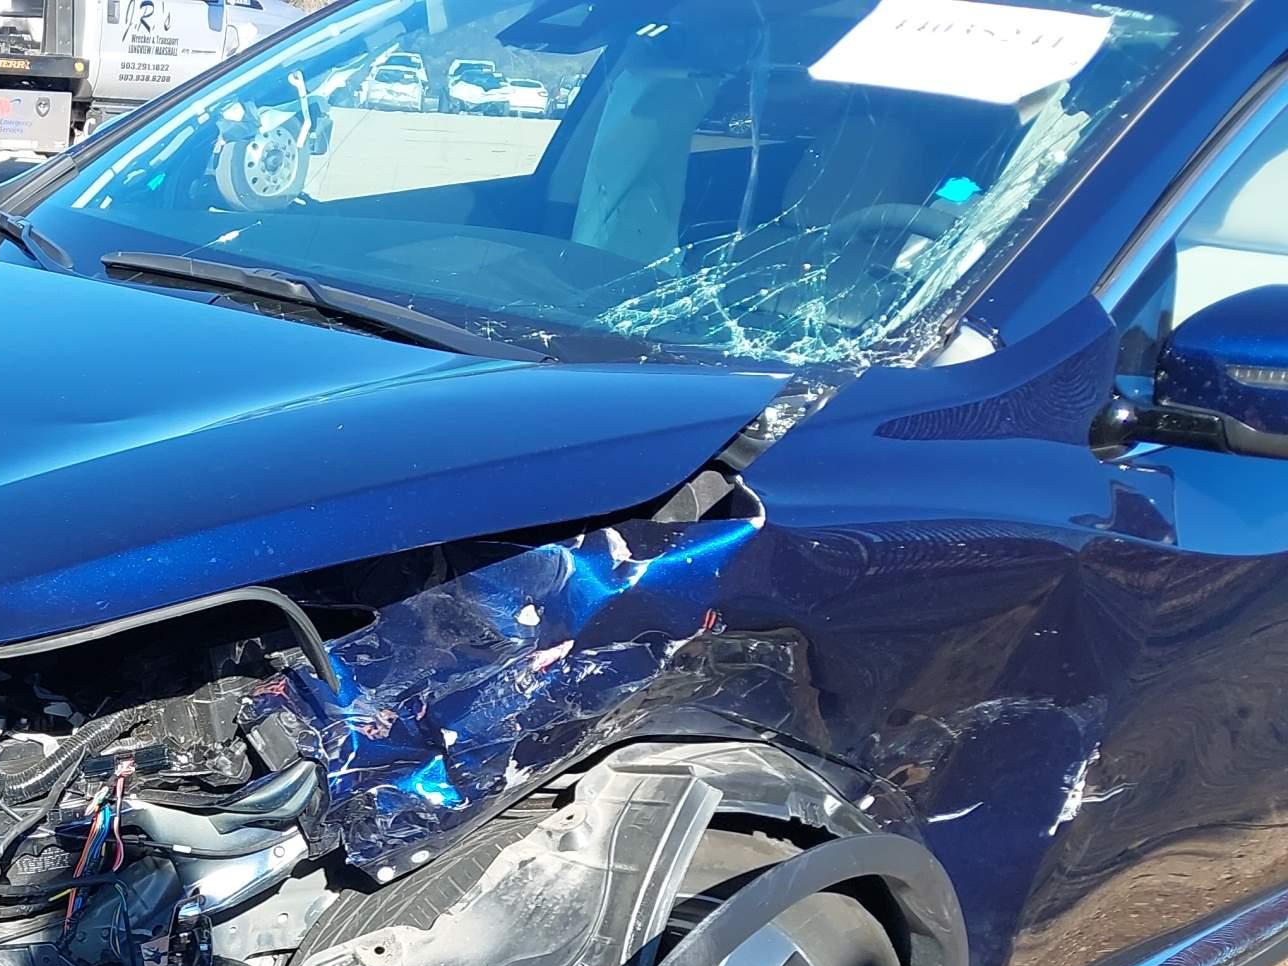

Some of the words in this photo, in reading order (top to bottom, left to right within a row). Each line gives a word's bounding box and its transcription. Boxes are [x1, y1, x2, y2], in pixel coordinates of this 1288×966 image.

[131, 34, 152, 44] Wrecker
[156, 35, 179, 46] Transport
[128, 44, 151, 55] LONGVIEW
[155, 45, 178, 56] MARSHALL
